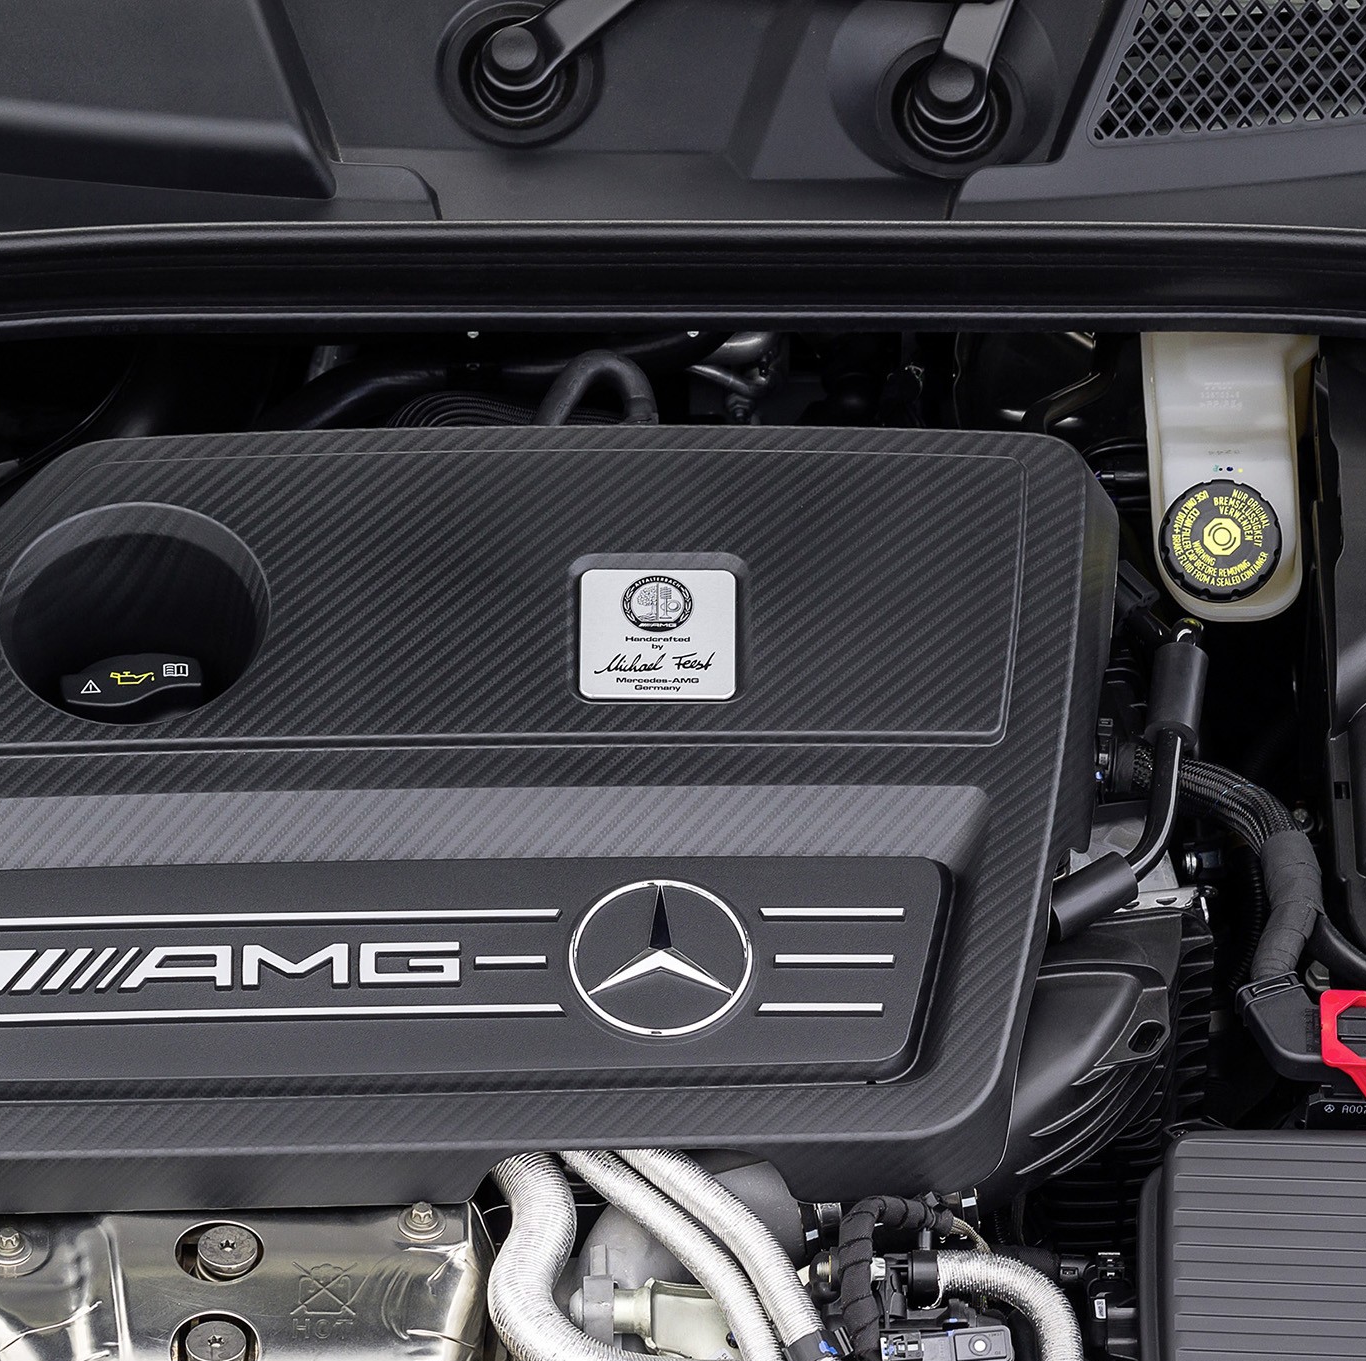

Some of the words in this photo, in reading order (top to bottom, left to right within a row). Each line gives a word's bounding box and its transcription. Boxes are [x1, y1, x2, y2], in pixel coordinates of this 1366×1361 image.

[1194, 490, 1209, 503] USE
[1232, 489, 1248, 502] NUR
[1247, 497, 1270, 529] ORIGINAL
[1219, 505, 1253, 541] VERWENDEN
[1172, 534, 1184, 556] BRAKE
[1192, 540, 1216, 566] WARNING
[1178, 555, 1195, 573] FLUID
[1185, 549, 1198, 561] CAP
[1194, 559, 1217, 577] BEFORE
[1219, 559, 1251, 577] REMOVING
[1240, 551, 1268, 581] CONTAINER
[635, 577, 681, 588] AFFALTERBACH
[1191, 569, 1211, 584] FROM
[1210, 577, 1215, 586] A
[1216, 575, 1241, 587] SEALED
[625, 635, 691, 643] Handcrafted
[651, 643, 664, 651] by
[594, 652, 667, 674] Michael
[634, 684, 681, 692] Germany
[118, 941, 461, 994] AMG
[292, 1318, 354, 1339] HOT
